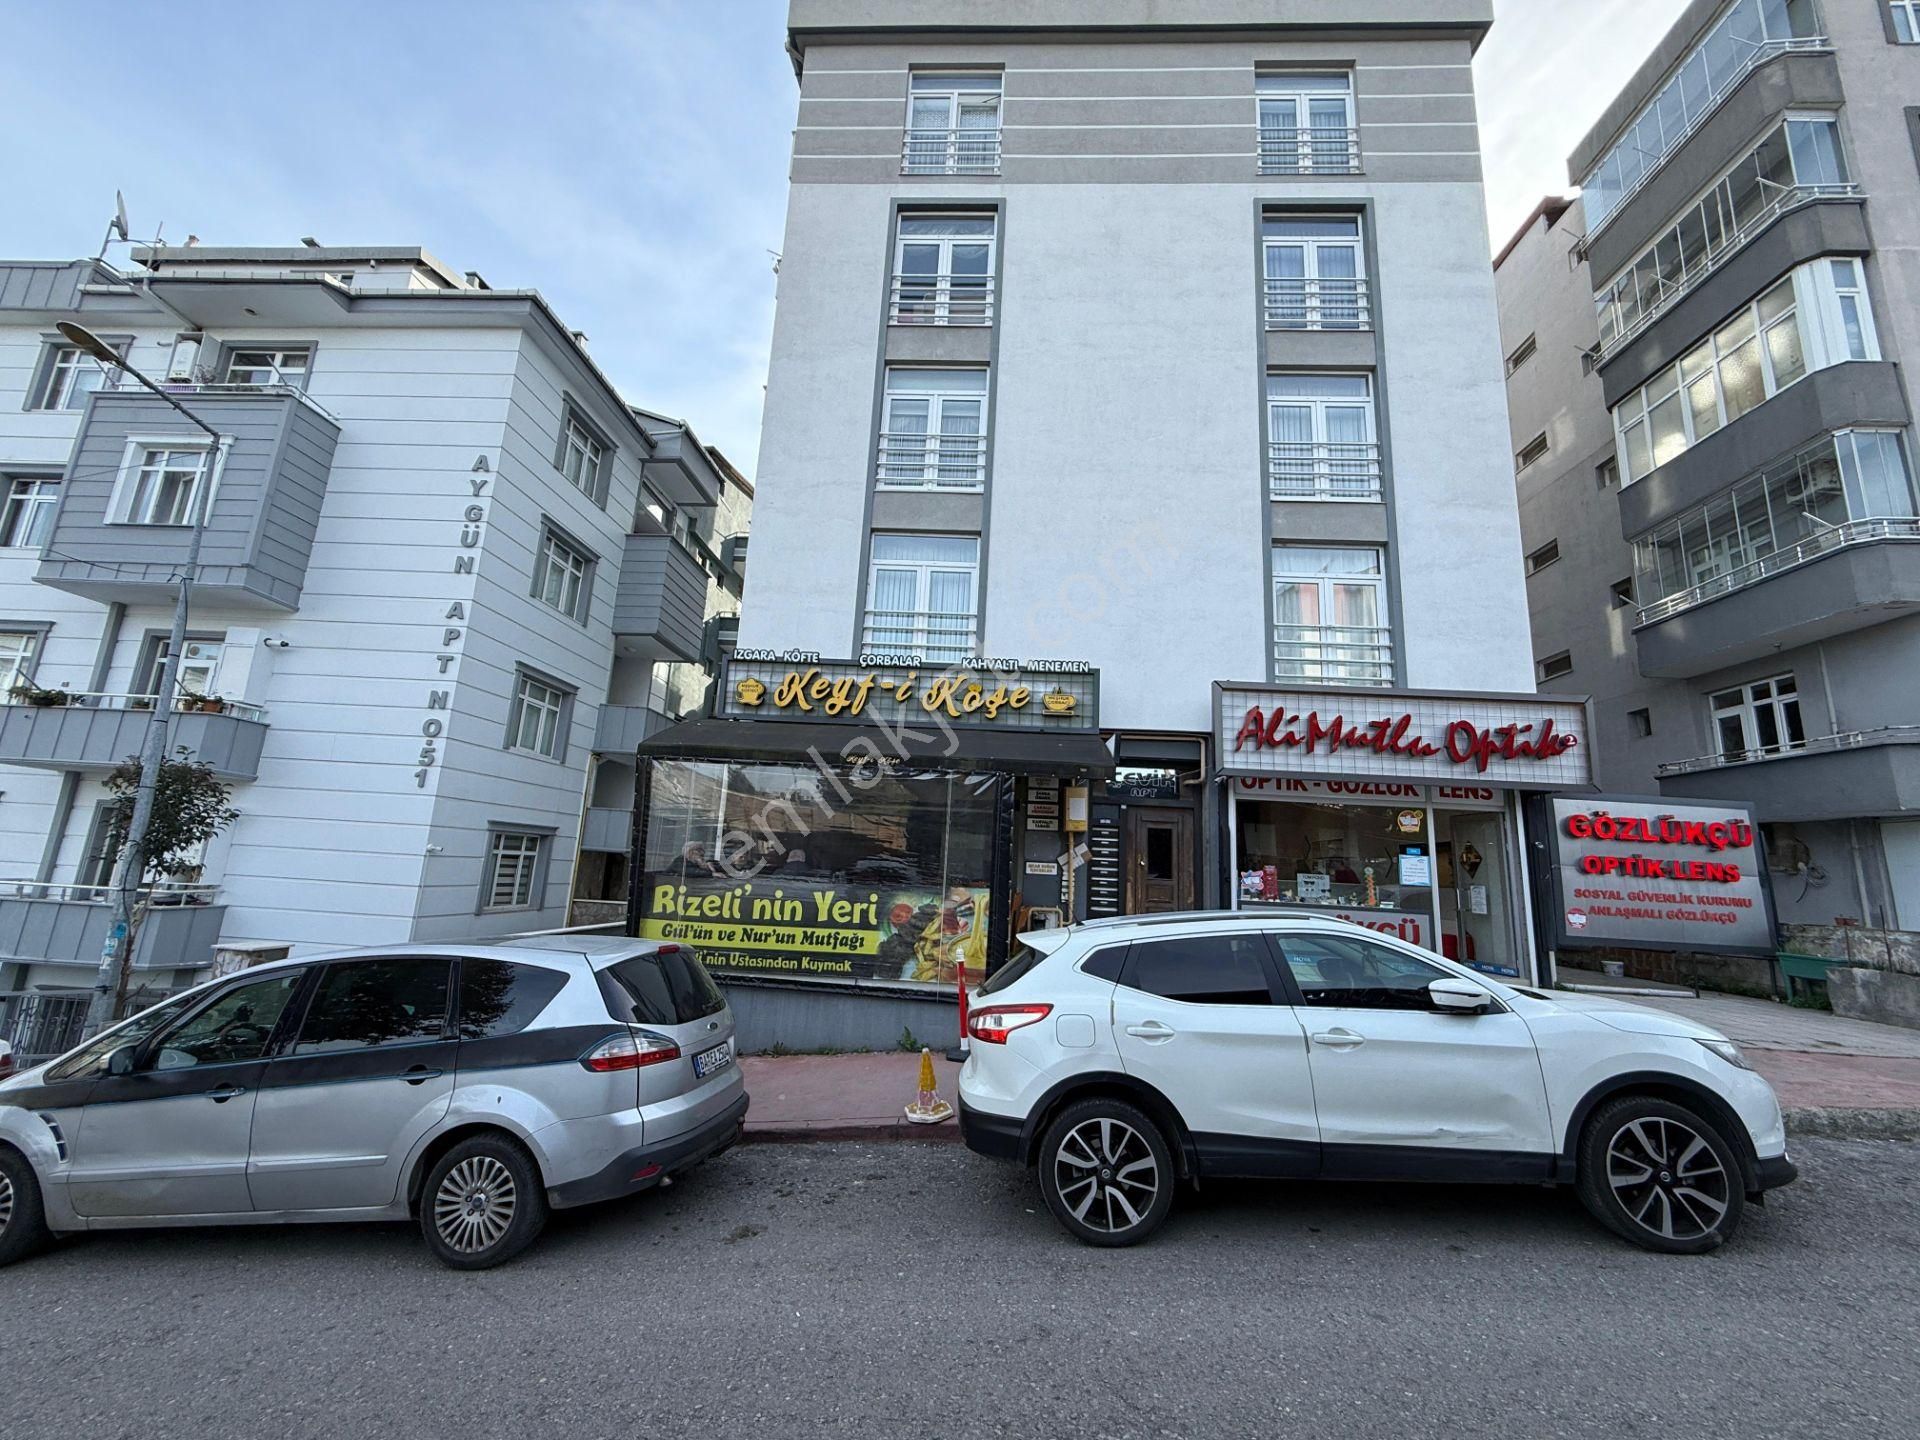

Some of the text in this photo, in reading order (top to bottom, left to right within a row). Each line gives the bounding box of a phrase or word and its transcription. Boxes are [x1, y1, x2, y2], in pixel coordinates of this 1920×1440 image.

[454, 454, 490, 574] AYGÜN
[437, 601, 464, 674] APT
[733, 647, 1089, 673] IZGARA KÖFTE ÇORBALAR KAHVALTI MENEMEN
[1235, 705, 1305, 751] Ali
[1444, 718, 1568, 773] Optik
[1130, 787, 1158, 798] APT
[1567, 810, 1753, 851] GÖZLÜKÇÜ
[652, 883, 879, 926] Rizeli'nin Yeri
[1574, 888, 1752, 909] SOSYAL GÜVENLİK KURUMU
[1588, 905, 1662, 920] ANLAŞMALI
[1666, 908, 1737, 925] GÖZLÜKÇÜ
[661, 923, 865, 951] Gül'ün ve Nur'un Mutfağı
[729, 953, 798, 970] Ustasından
[801, 957, 852, 972] Kuymak
